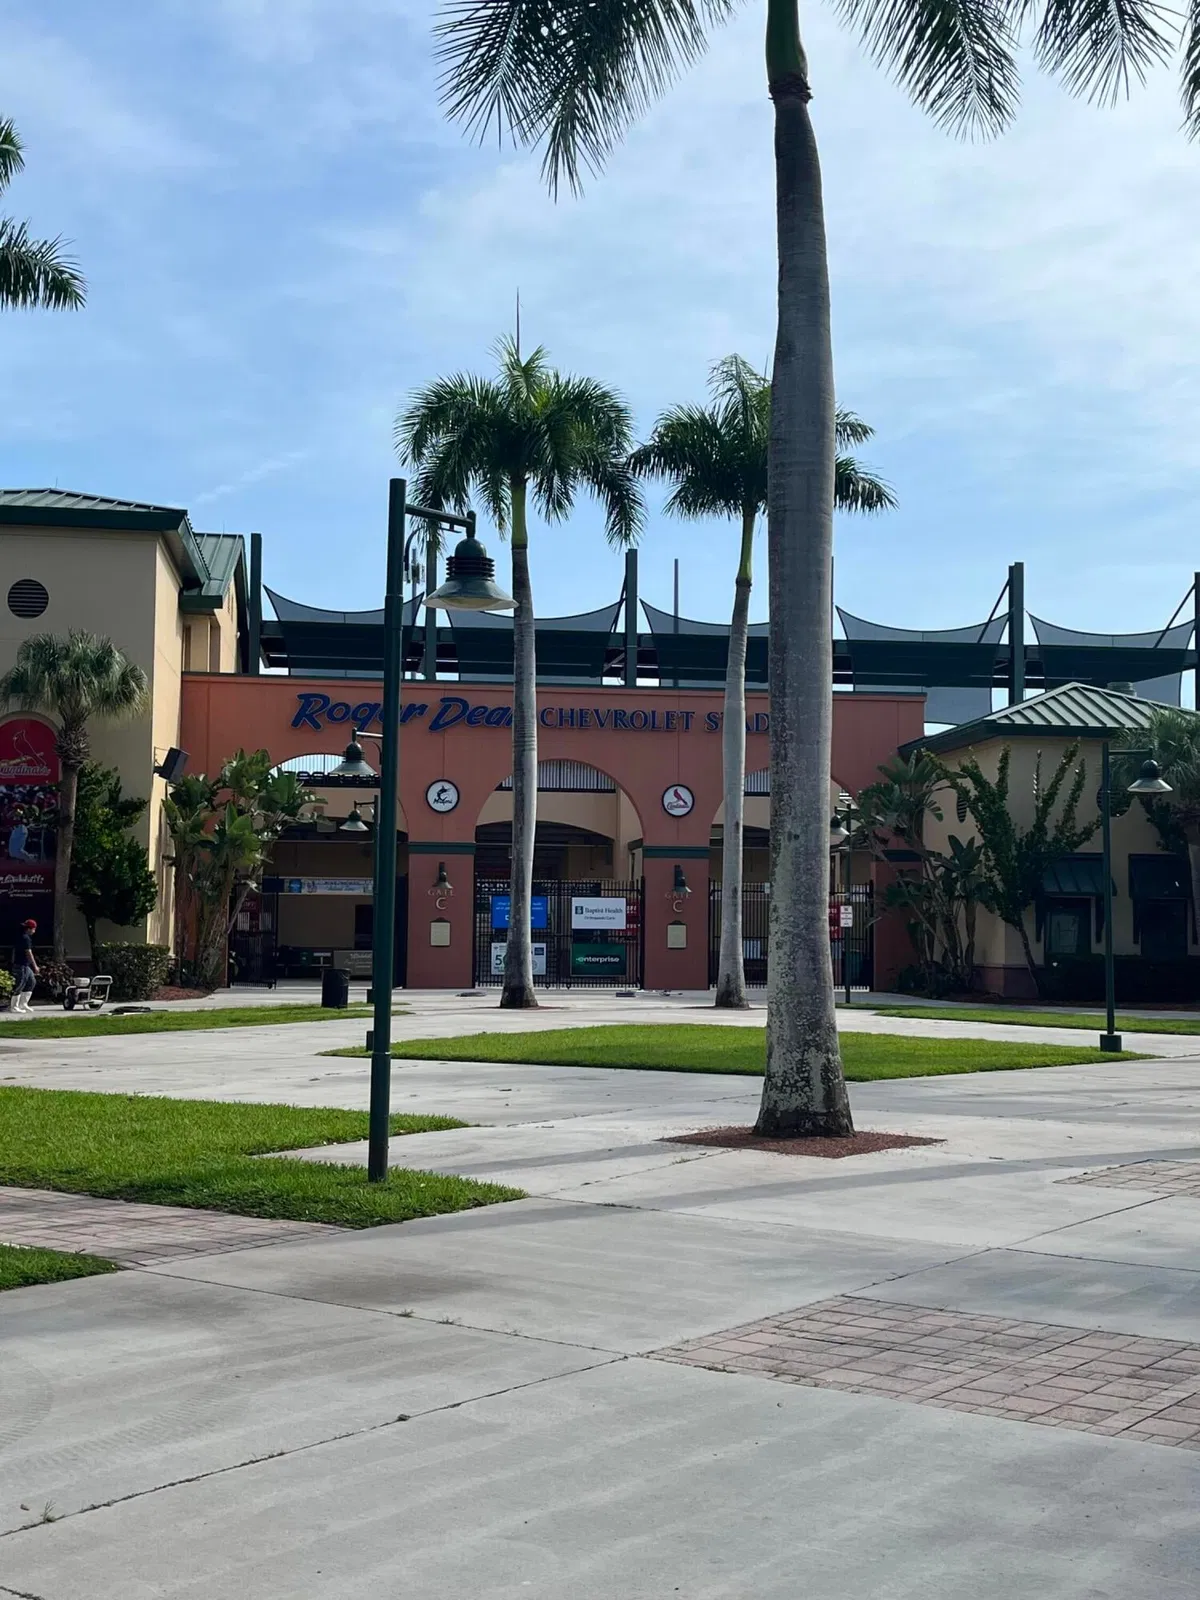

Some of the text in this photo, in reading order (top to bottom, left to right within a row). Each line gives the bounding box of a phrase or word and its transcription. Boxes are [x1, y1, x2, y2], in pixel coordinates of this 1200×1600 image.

[428, 696, 514, 733] Dea
[540, 707, 696, 732] CHEVROLET
[435, 897, 448, 910] C
[672, 900, 683, 912] C
[605, 906, 623, 914] Health
[575, 955, 620, 964] enterprise
